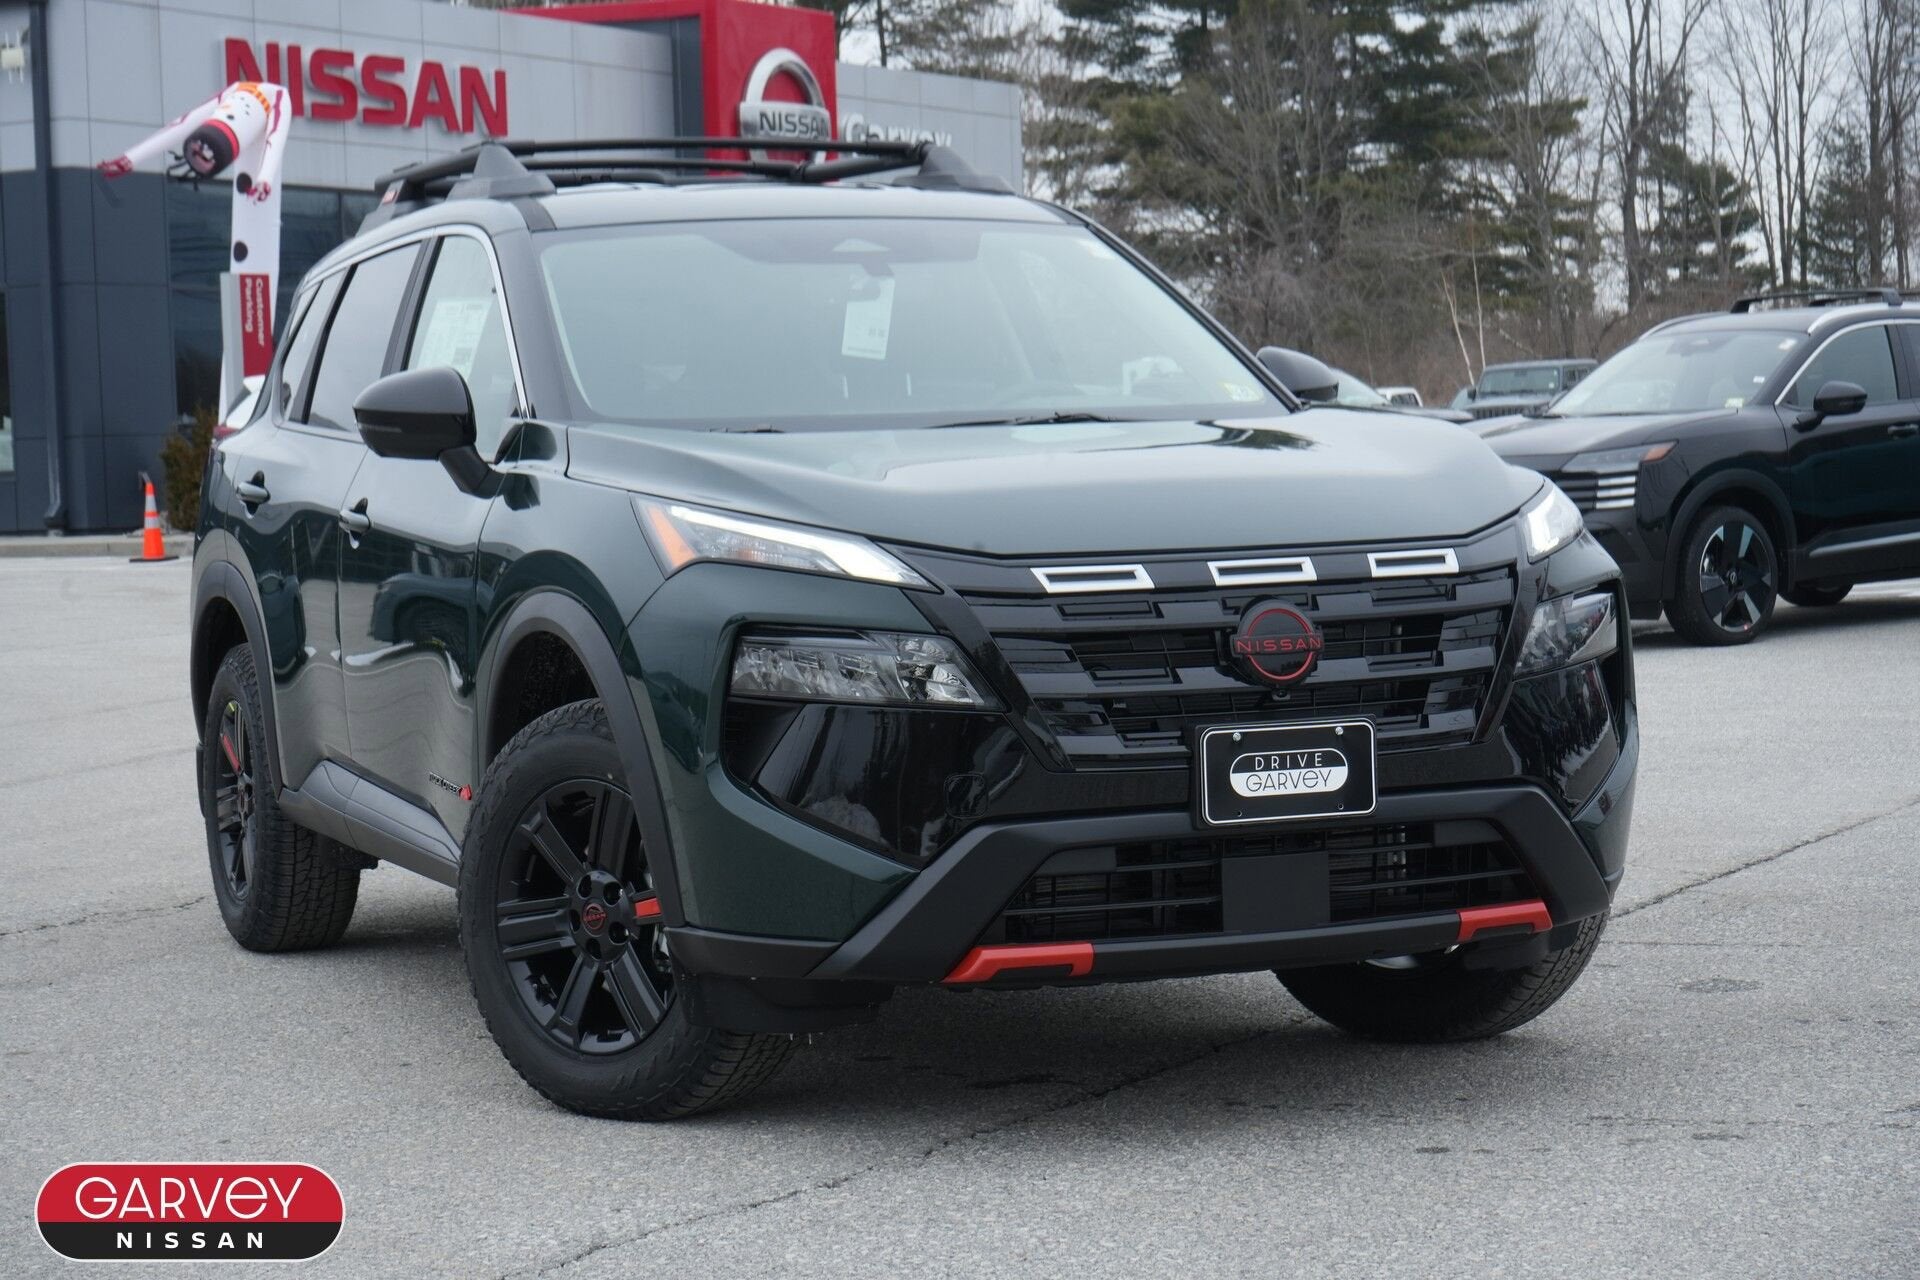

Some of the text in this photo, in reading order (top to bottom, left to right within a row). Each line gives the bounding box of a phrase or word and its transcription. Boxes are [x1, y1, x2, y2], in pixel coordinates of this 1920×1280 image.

[224, 36, 508, 137] NISSAN
[759, 110, 829, 140] NISSAN
[1236, 636, 1322, 654] NISSAN
[1254, 752, 1323, 771] DRIVE
